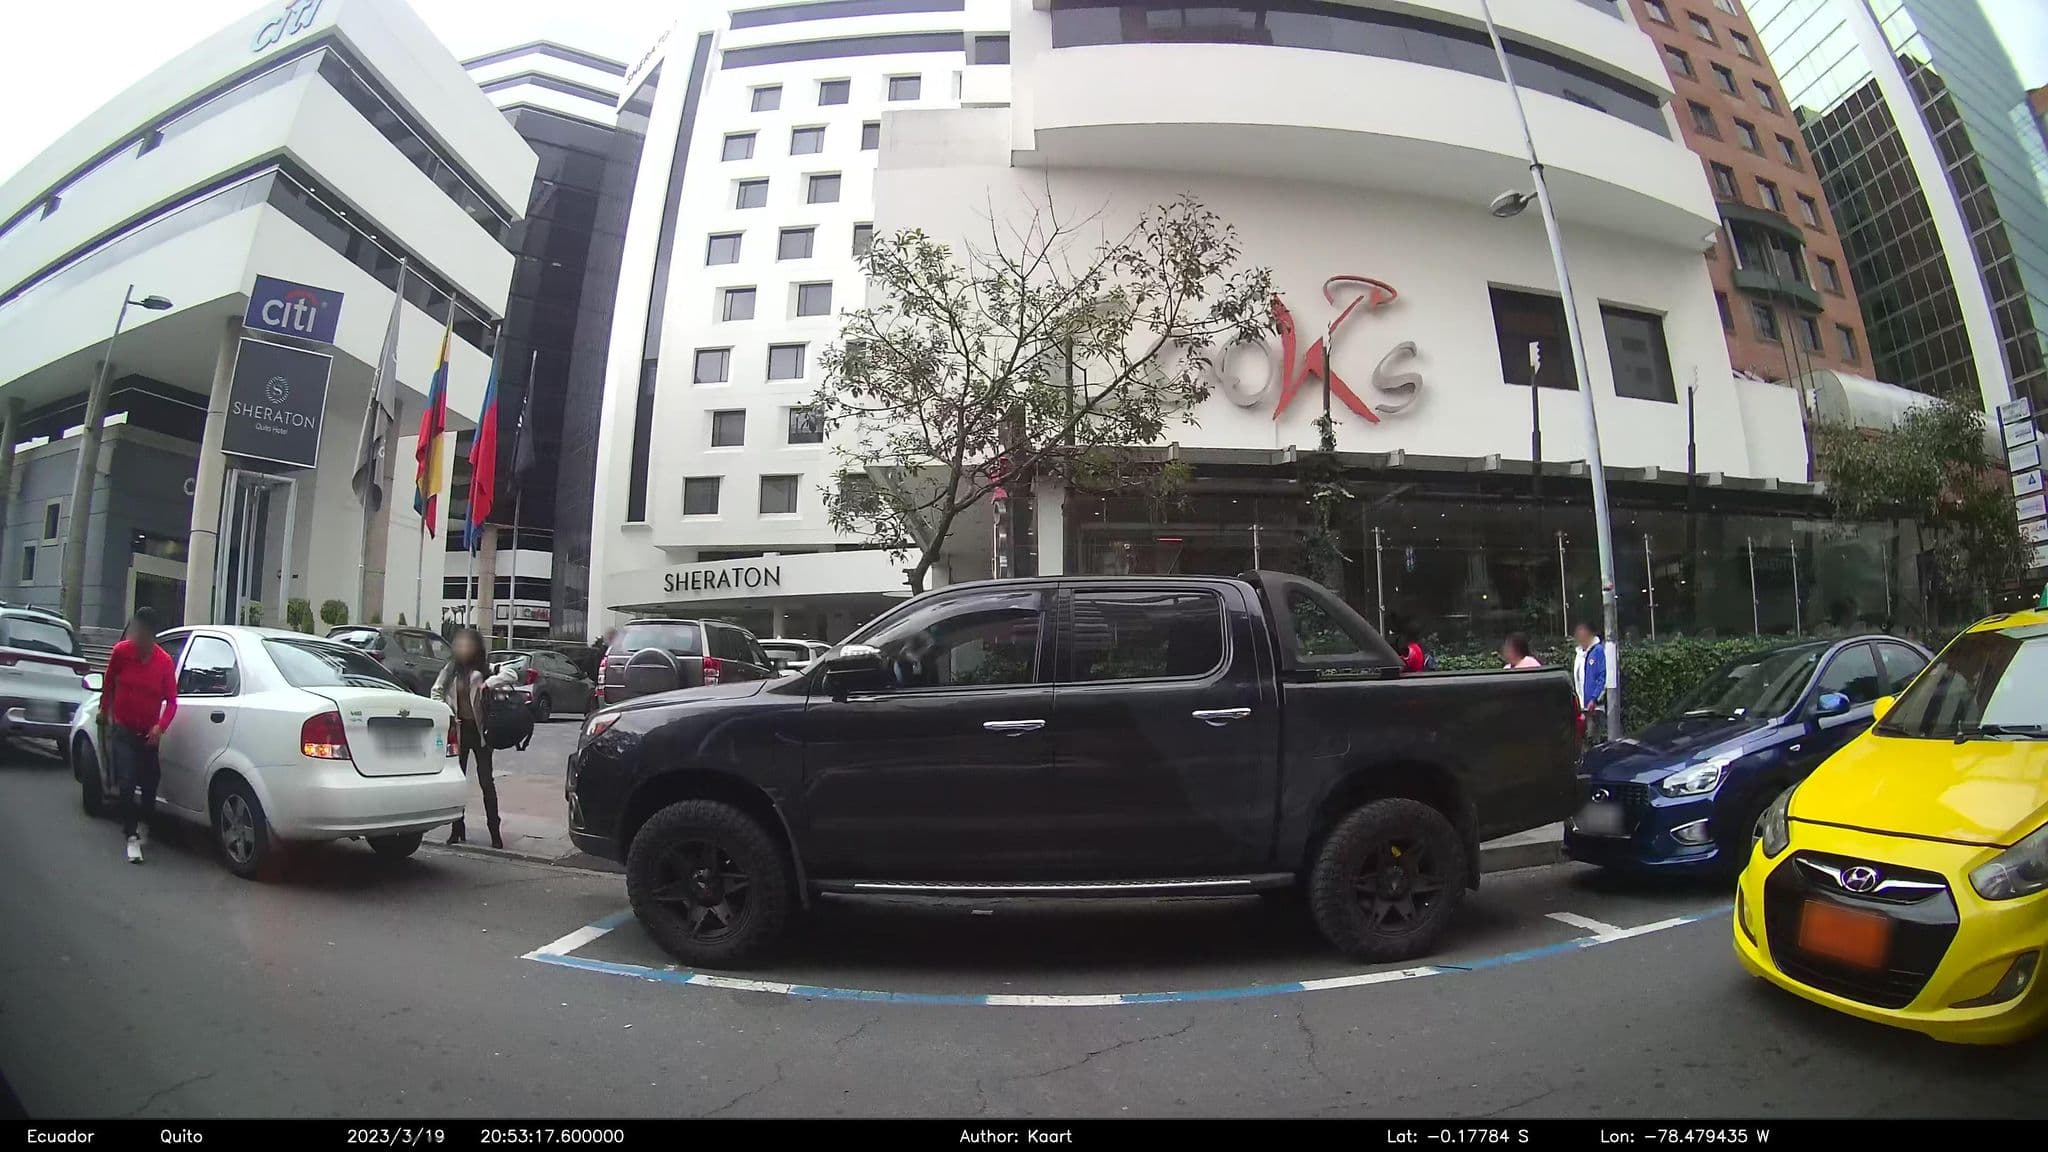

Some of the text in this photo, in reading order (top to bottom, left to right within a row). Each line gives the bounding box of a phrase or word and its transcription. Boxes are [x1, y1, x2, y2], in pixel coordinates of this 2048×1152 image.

[251, 0, 323, 53] citi
[261, 298, 317, 333] citi
[233, 401, 315, 429] SHERATON
[255, 422, 288, 435] Quito Hotel
[664, 566, 781, 592] SHERATON
